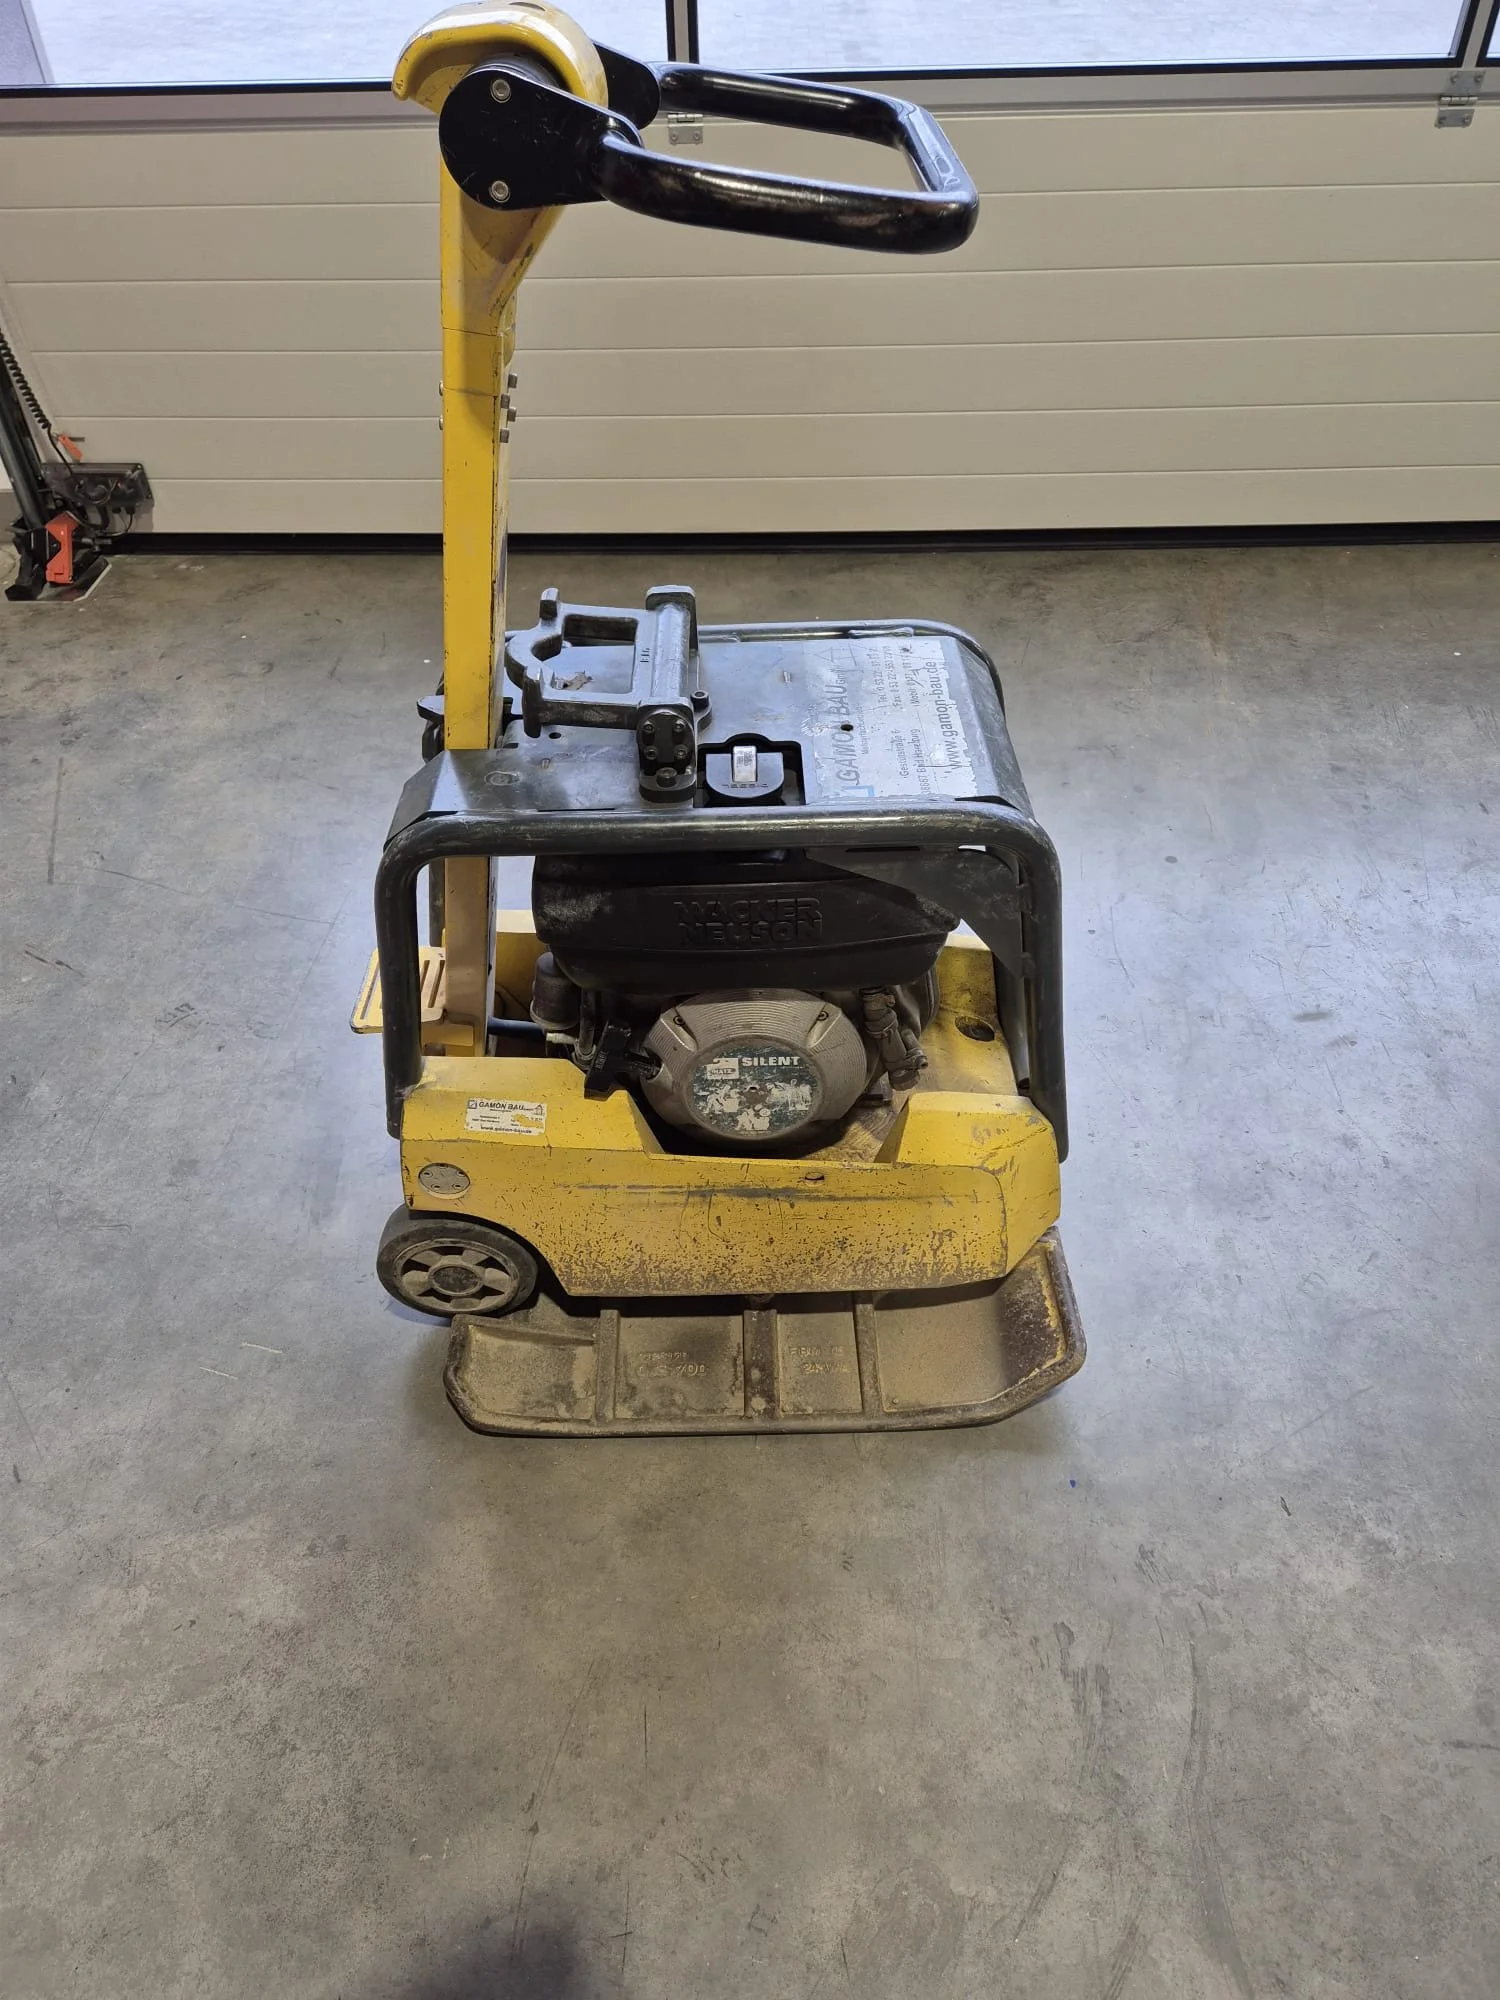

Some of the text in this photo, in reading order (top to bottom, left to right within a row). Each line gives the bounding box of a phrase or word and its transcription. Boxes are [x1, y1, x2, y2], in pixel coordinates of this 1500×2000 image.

[826, 684, 849, 715] BAU
[926, 661, 962, 770] www.gamon-bau.de
[673, 899, 823, 922] WACKER
[679, 921, 823, 945] NEUSON
[742, 1056, 800, 1067] SILENT
